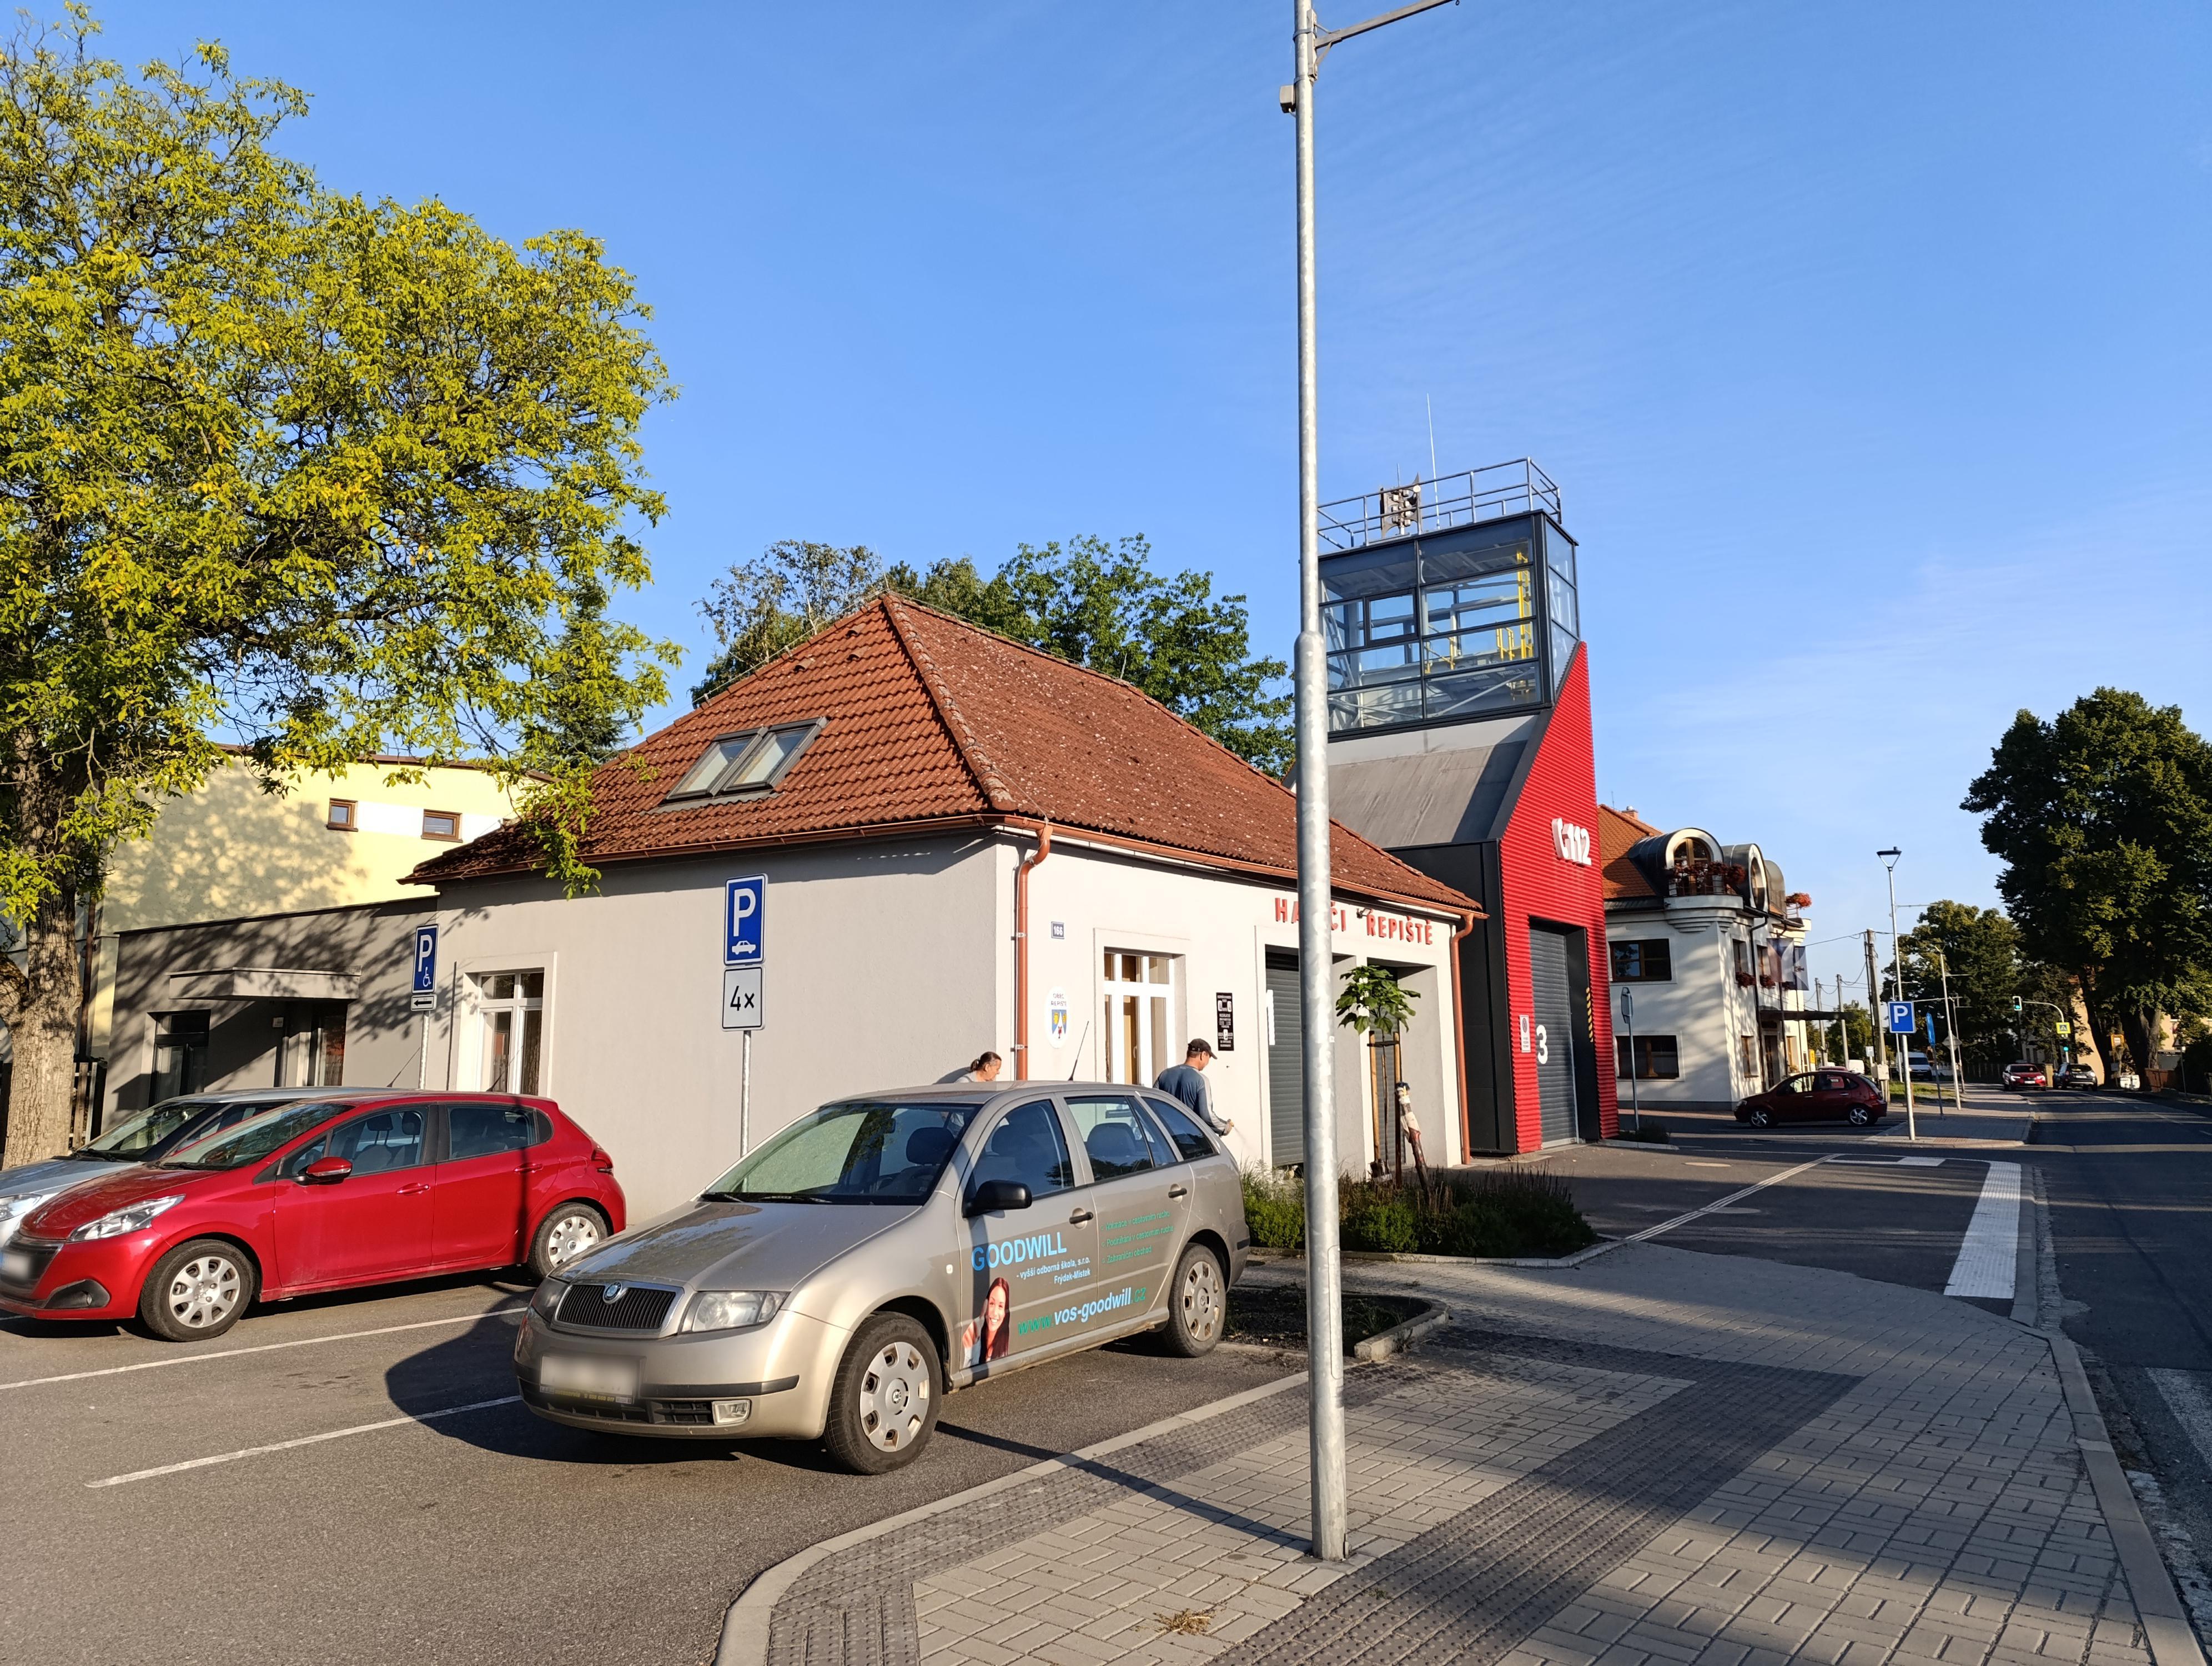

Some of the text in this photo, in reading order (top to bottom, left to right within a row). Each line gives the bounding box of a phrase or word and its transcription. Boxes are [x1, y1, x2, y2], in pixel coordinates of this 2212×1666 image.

[1562, 823, 1592, 866] 112
[733, 888, 756, 937] P
[1054, 925, 1063, 935] 166
[1366, 908, 1432, 945] ŘEPIŠTĚ
[418, 934, 433, 972] P
[730, 986, 755, 1011] 4x
[1893, 1005, 1908, 1023] P
[1536, 1025, 1548, 1064] 3
[972, 1232, 1067, 1271] GOODWILL
[1020, 1267, 1035, 1280] vyšší
[1037, 1262, 1060, 1274] odborná
[1061, 1259, 1077, 1269] škola,
[1078, 1257, 1090, 1266] s.r.o.
[1054, 1268, 1090, 1285] Frýdek-Místek
[1018, 1287, 1146, 1336] www.vos-goodwill.cz
